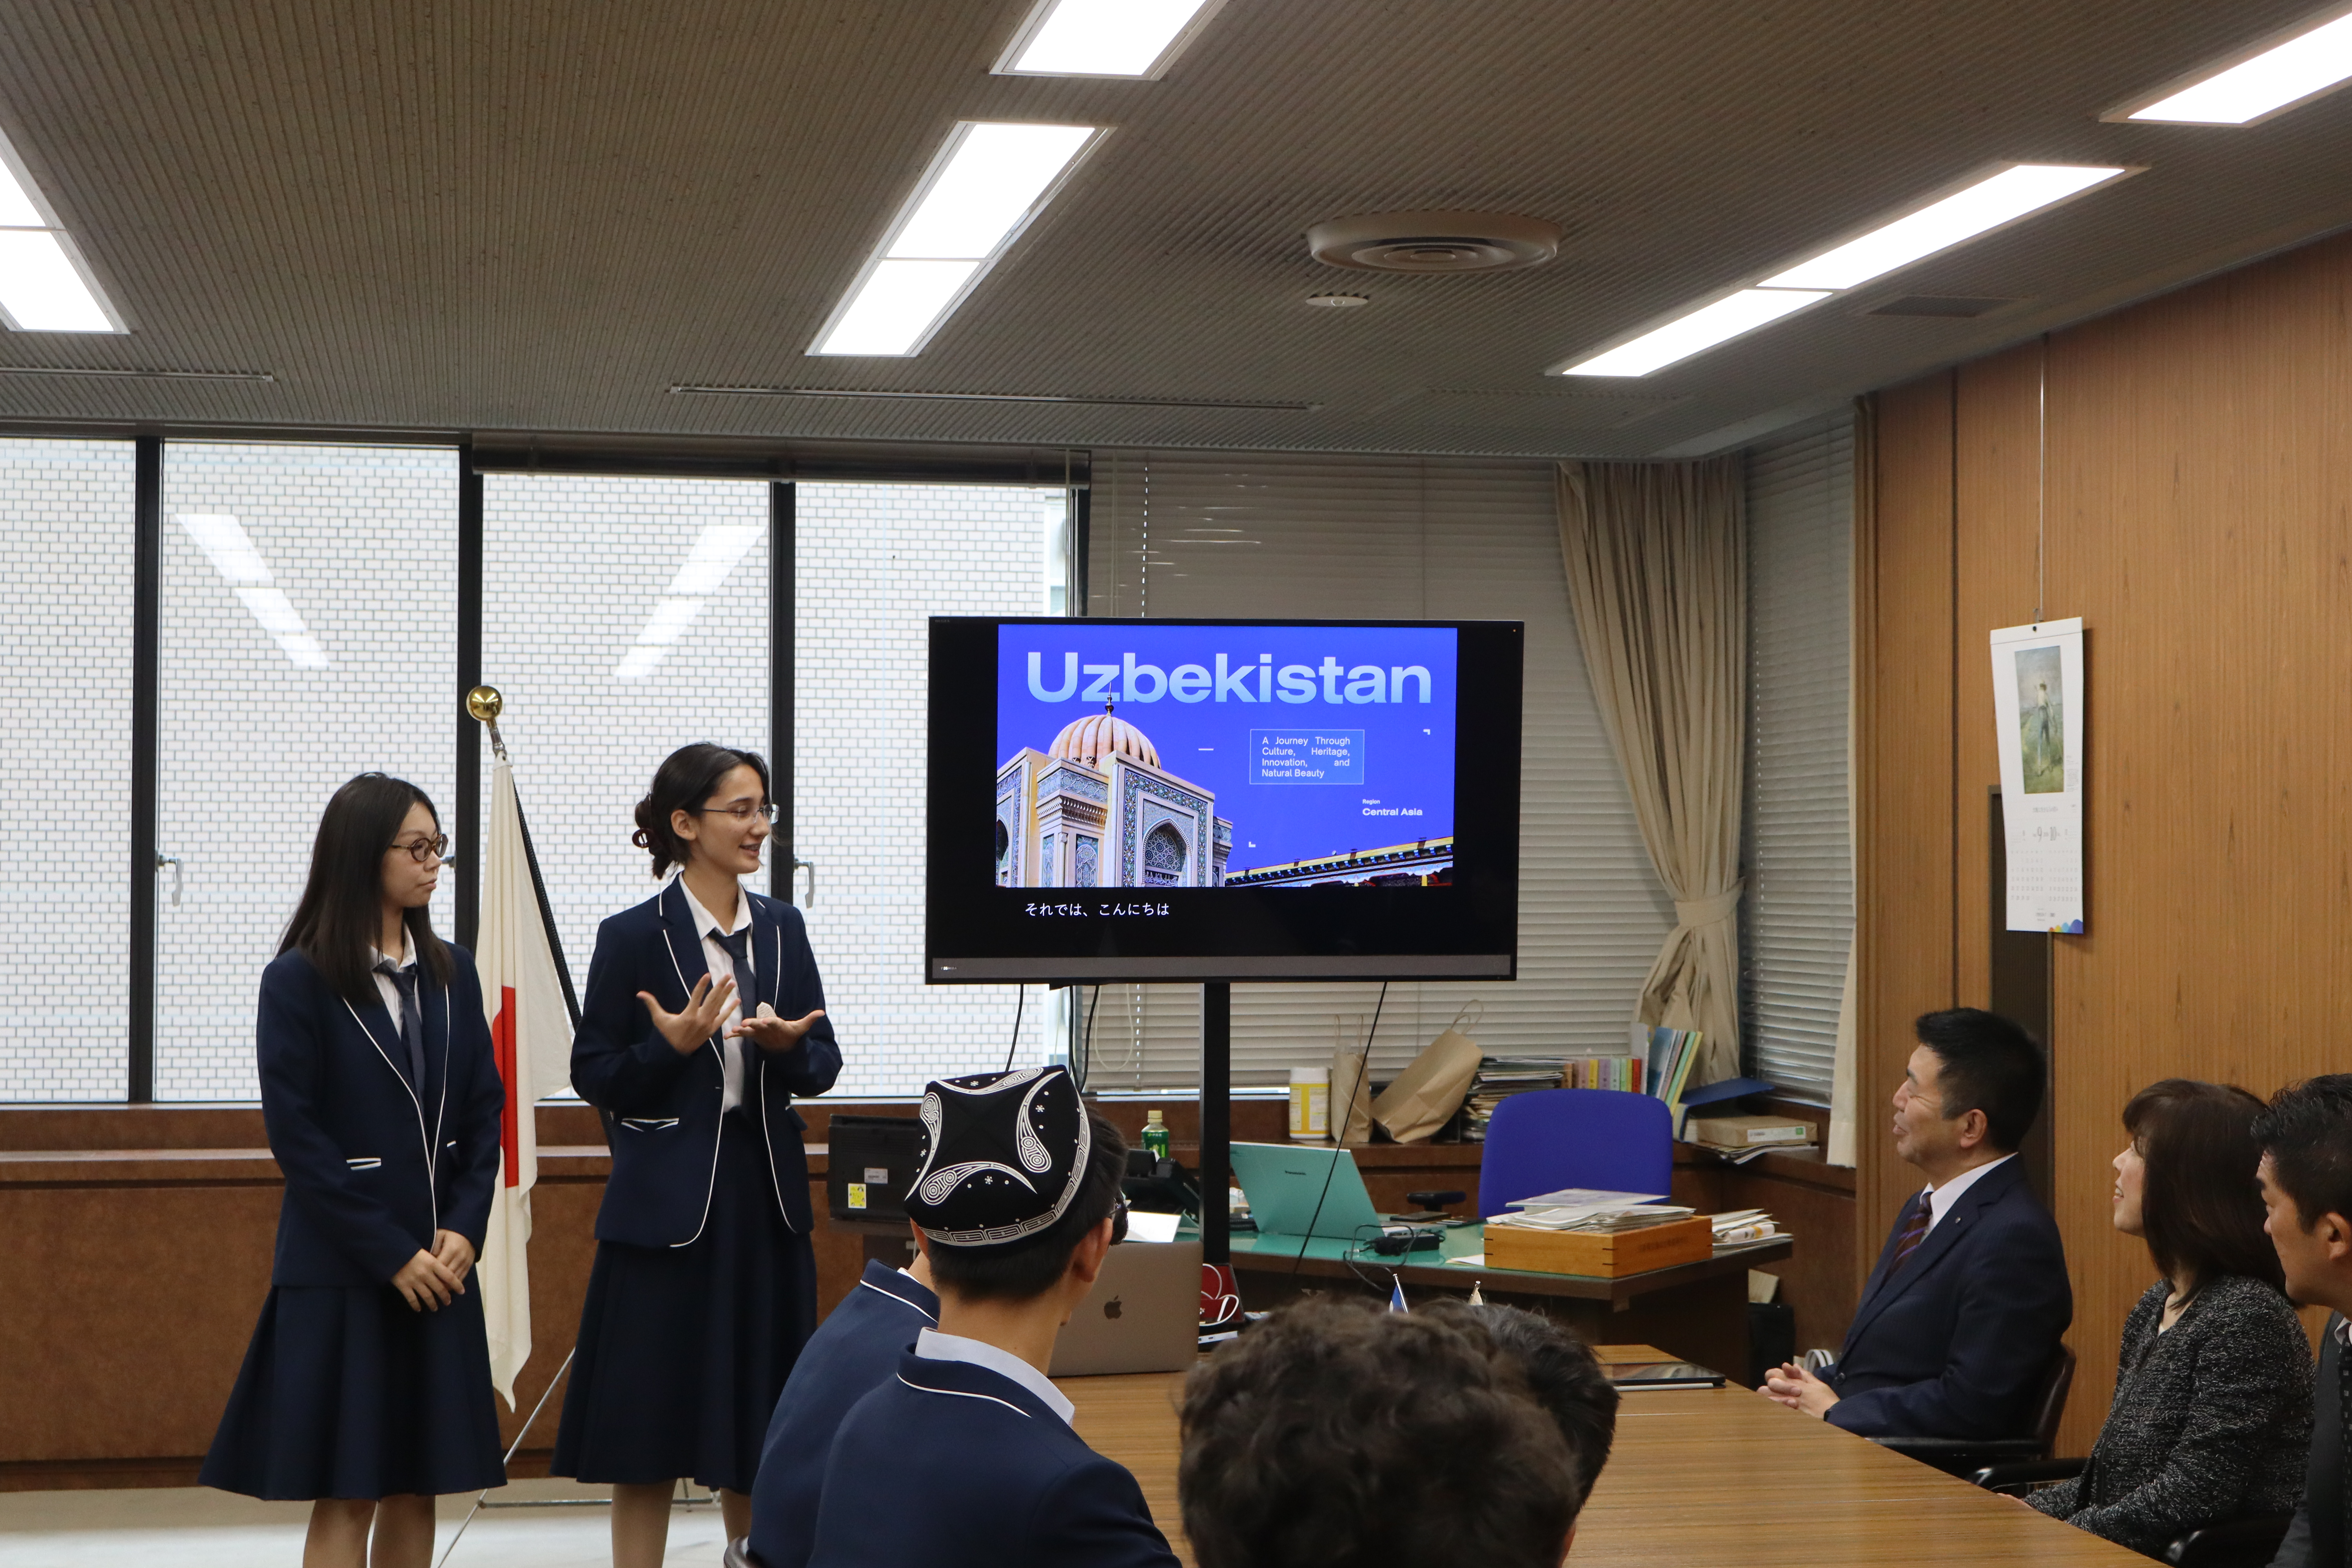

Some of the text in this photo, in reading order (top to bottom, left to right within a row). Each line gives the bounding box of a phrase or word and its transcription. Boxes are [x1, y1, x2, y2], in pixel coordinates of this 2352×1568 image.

[1027, 652, 1432, 704] Uzbekistan
[1262, 736, 1350, 746] A Journey Through
[1262, 747, 1350, 757] Culture, Heritage,
[1262, 758, 1308, 768] Innovation,
[1262, 769, 1325, 779] Natural Beauty
[1362, 808, 1399, 816] Central
[1025, 902, 1169, 916] それでは、こんにちは
